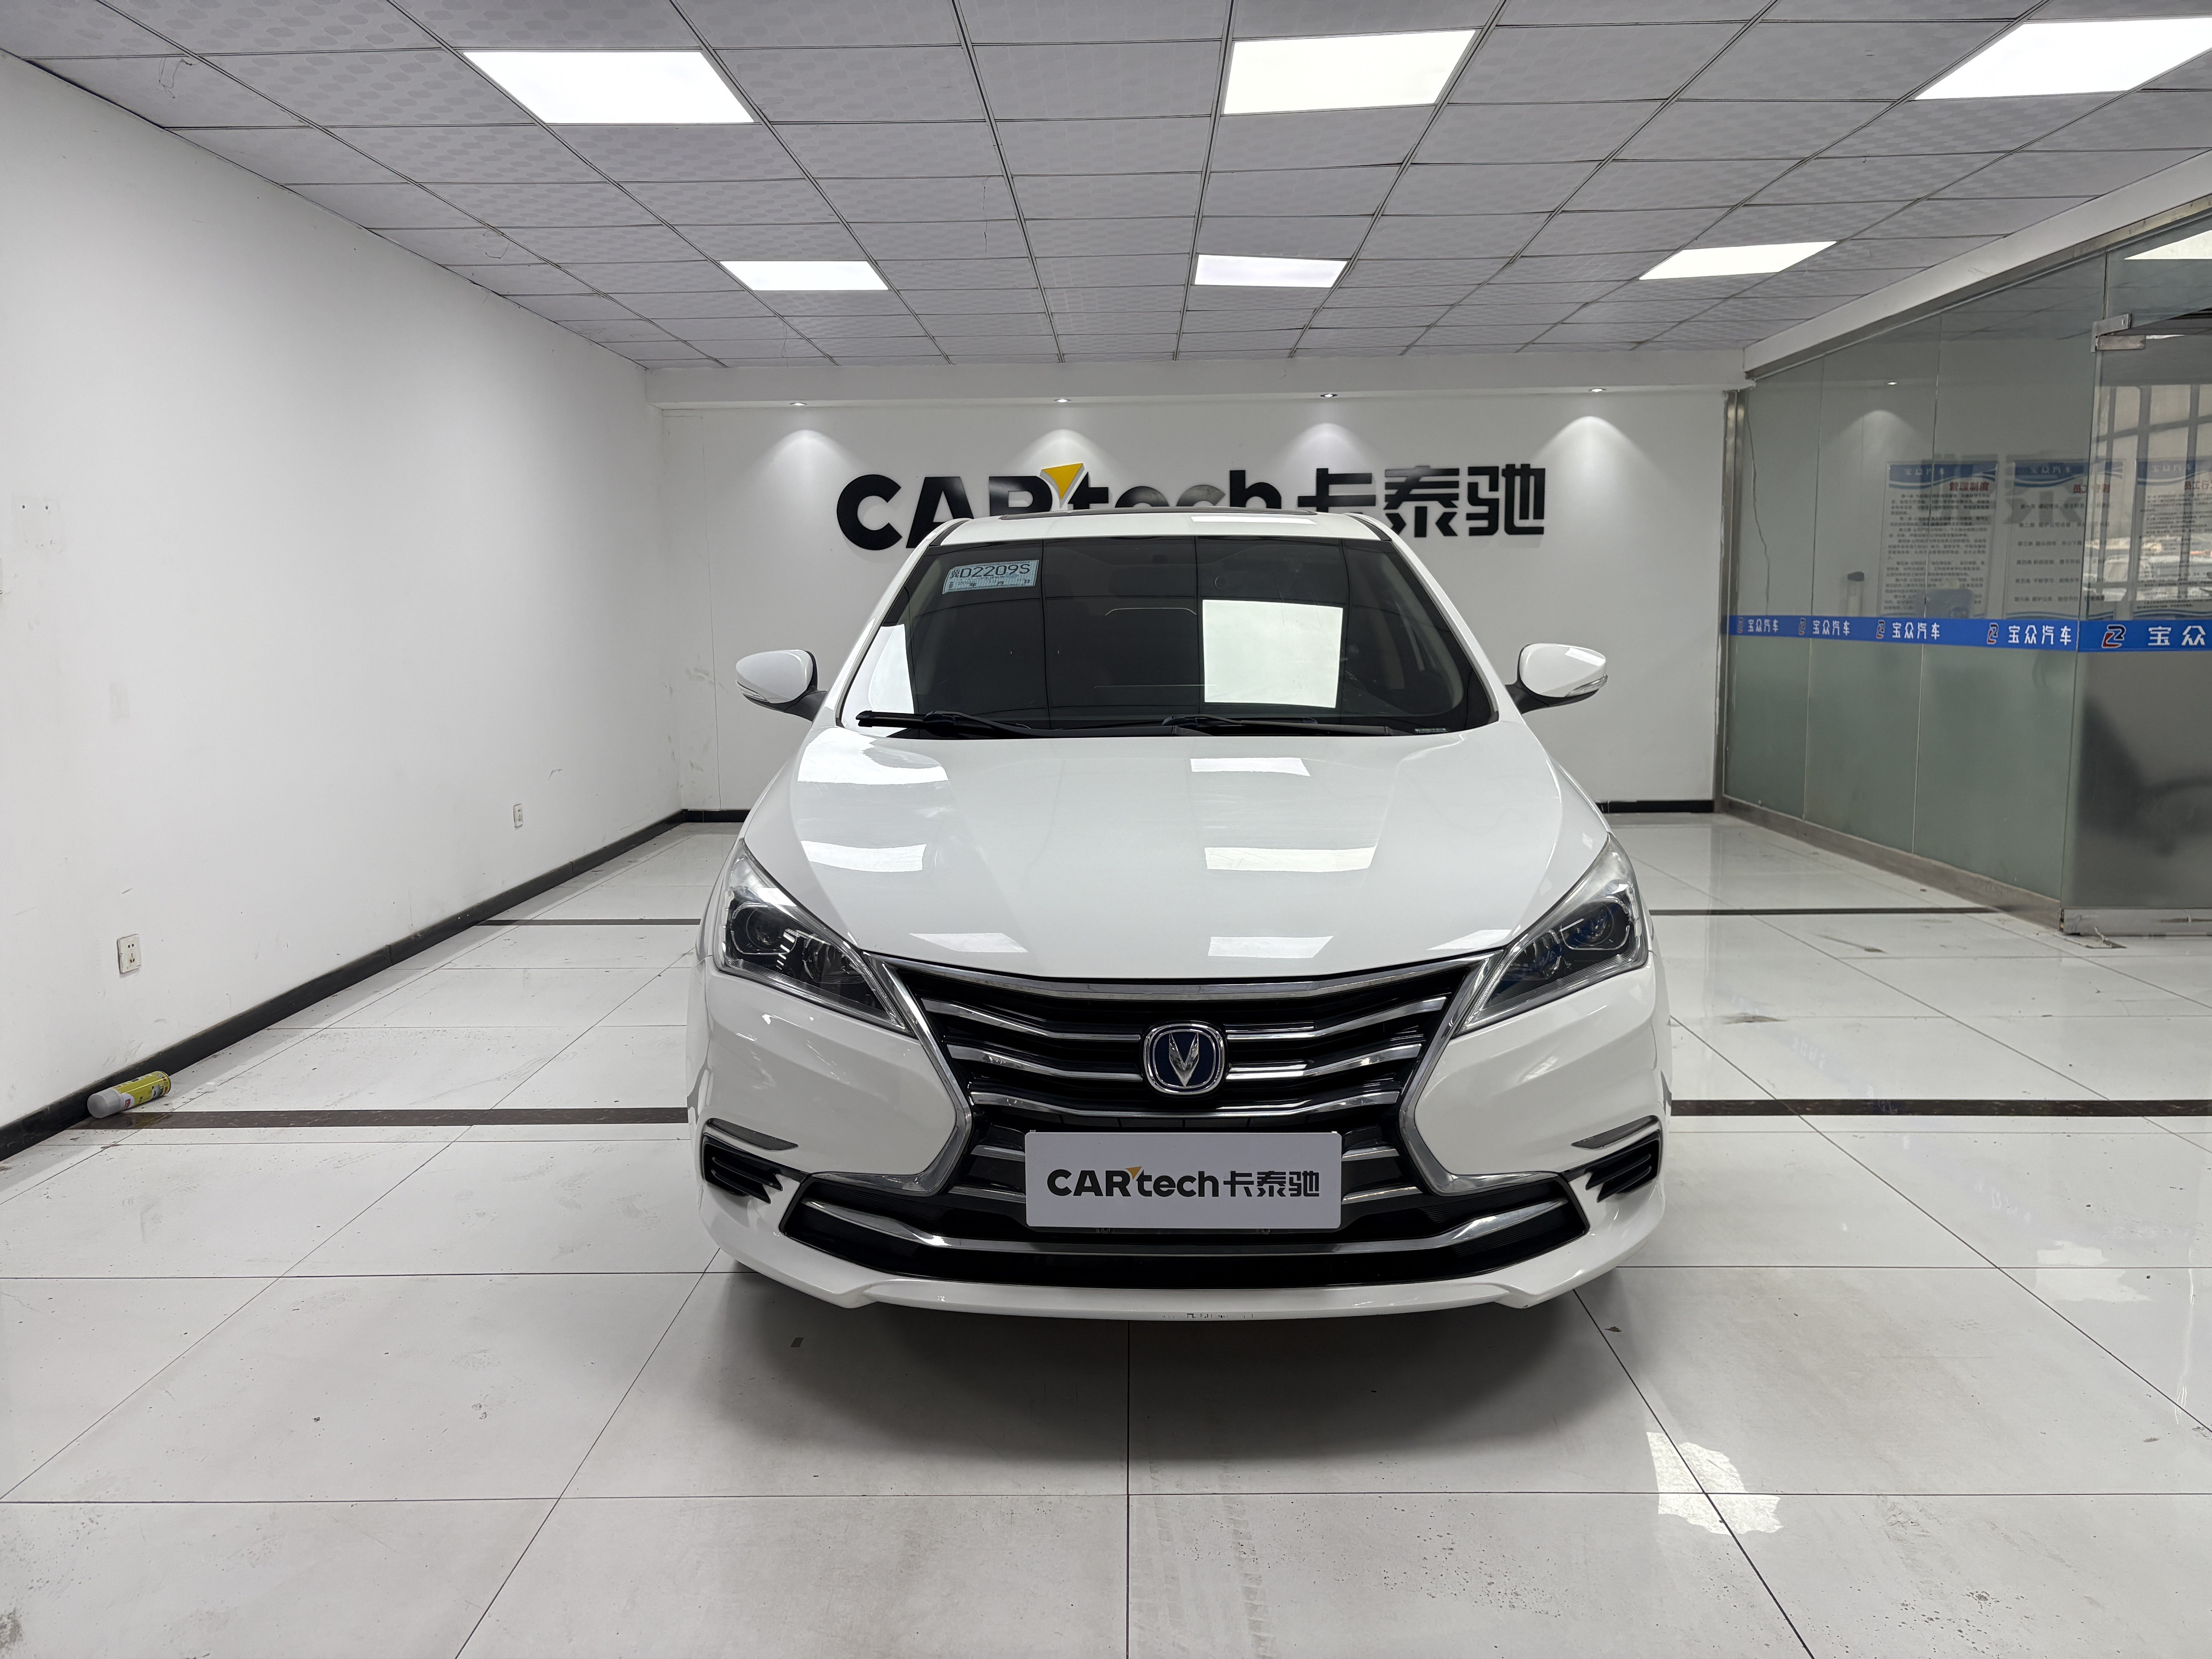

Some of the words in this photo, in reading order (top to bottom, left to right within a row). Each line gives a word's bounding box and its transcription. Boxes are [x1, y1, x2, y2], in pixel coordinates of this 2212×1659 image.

[2184, 480, 2212, 490] 员工行
[1747, 618, 1779, 633] 宝众汽车
[1812, 620, 1850, 636] 宝众汽车
[1892, 622, 1940, 640] 宝众汽车
[2008, 625, 2072, 645] 宝众汽车
[2147, 625, 2206, 646] 宝众
